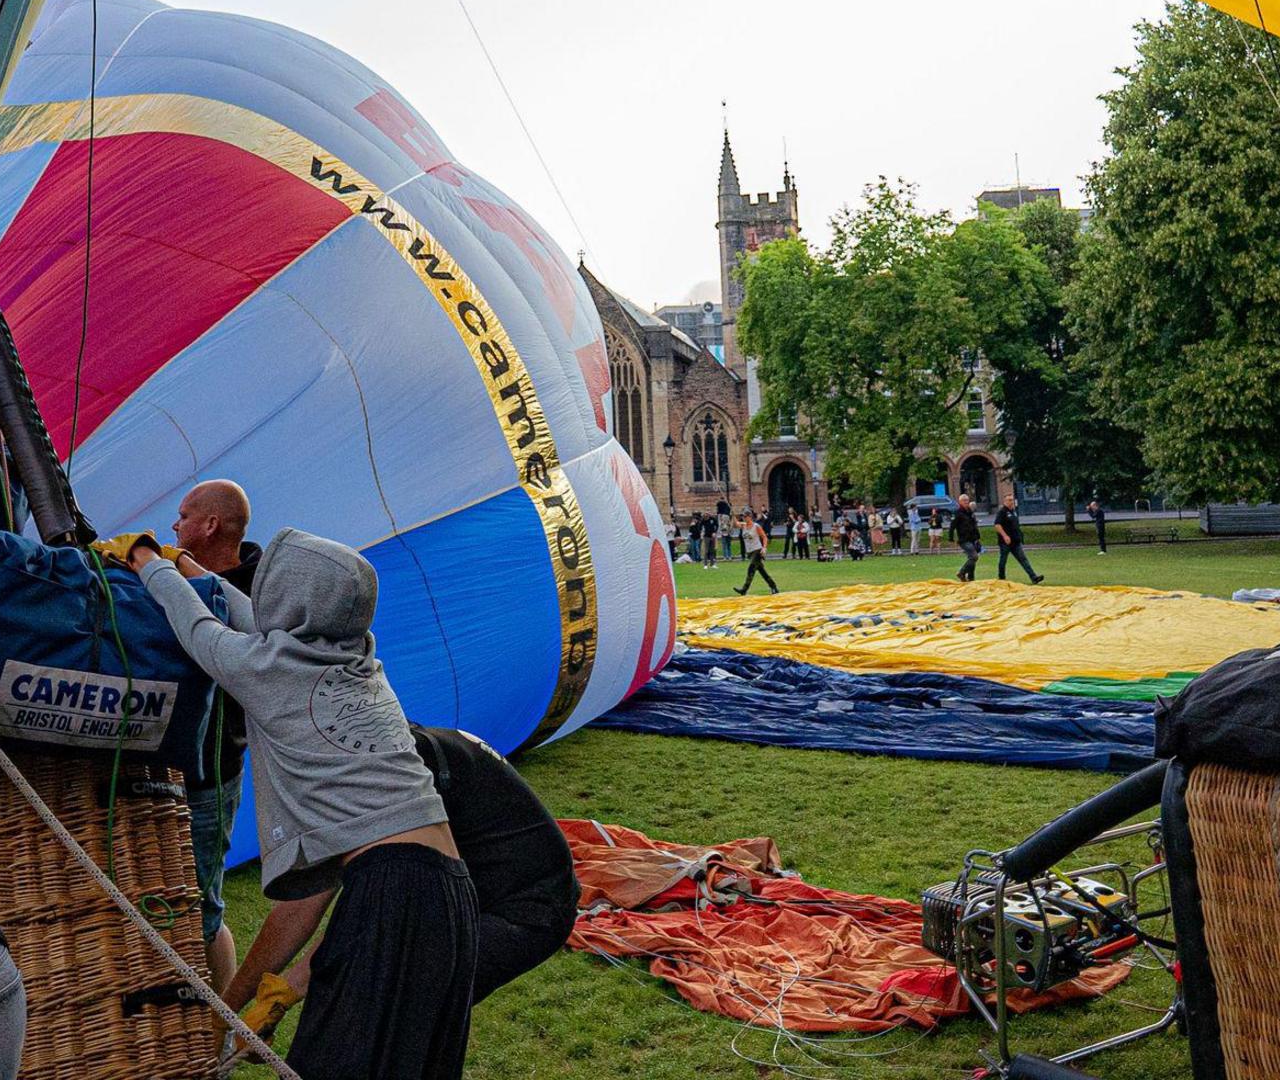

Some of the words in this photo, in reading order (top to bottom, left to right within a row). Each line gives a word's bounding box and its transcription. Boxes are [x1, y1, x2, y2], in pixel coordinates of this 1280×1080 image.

[11, 674, 166, 718] CAMERON
[13, 709, 73, 733] BRISTOL
[79, 719, 143, 738] ENGLAND
[325, 724, 377, 753] MADE
